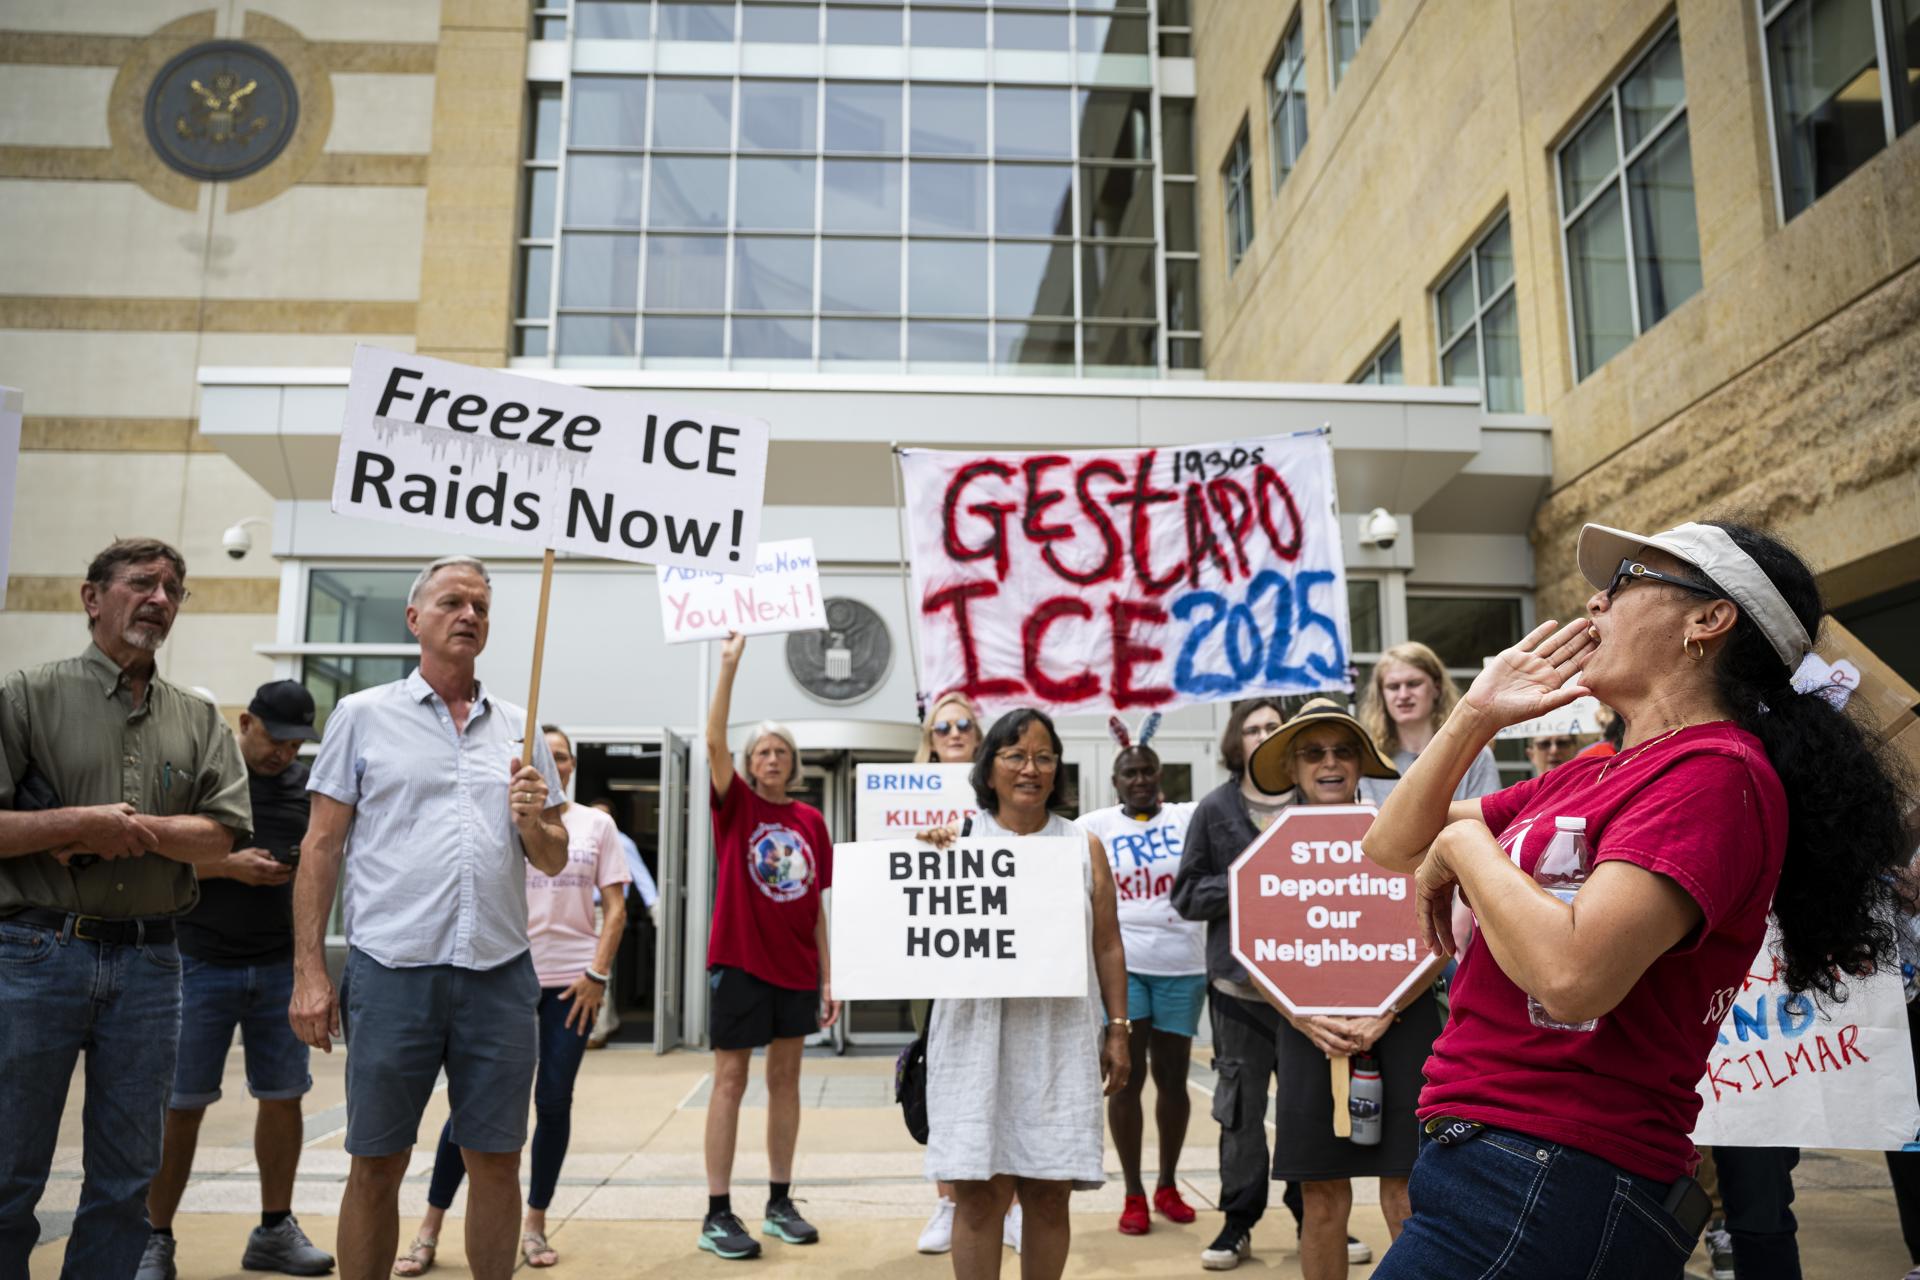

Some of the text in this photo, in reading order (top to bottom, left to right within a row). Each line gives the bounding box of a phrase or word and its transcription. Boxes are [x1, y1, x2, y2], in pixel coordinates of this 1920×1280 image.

[376, 366, 741, 477] Freeze ICE
[1173, 446, 1264, 484] 1930s
[350, 450, 744, 562] Raids Now!
[668, 583, 816, 632] You Next!
[922, 569, 1345, 711] ICE 2025
[866, 774, 943, 791] BRING
[889, 848, 1016, 881] BRING
[1112, 825, 1185, 868] FREE
[903, 884, 1008, 916] THEM
[1259, 873, 1407, 902] Deporting
[1306, 906, 1362, 929] Our
[906, 926, 1017, 959] HOME
[1253, 938, 1417, 967] Neighbors!
[1717, 994, 1816, 1046] ND
[1706, 1023, 1871, 1103] KILMAR
